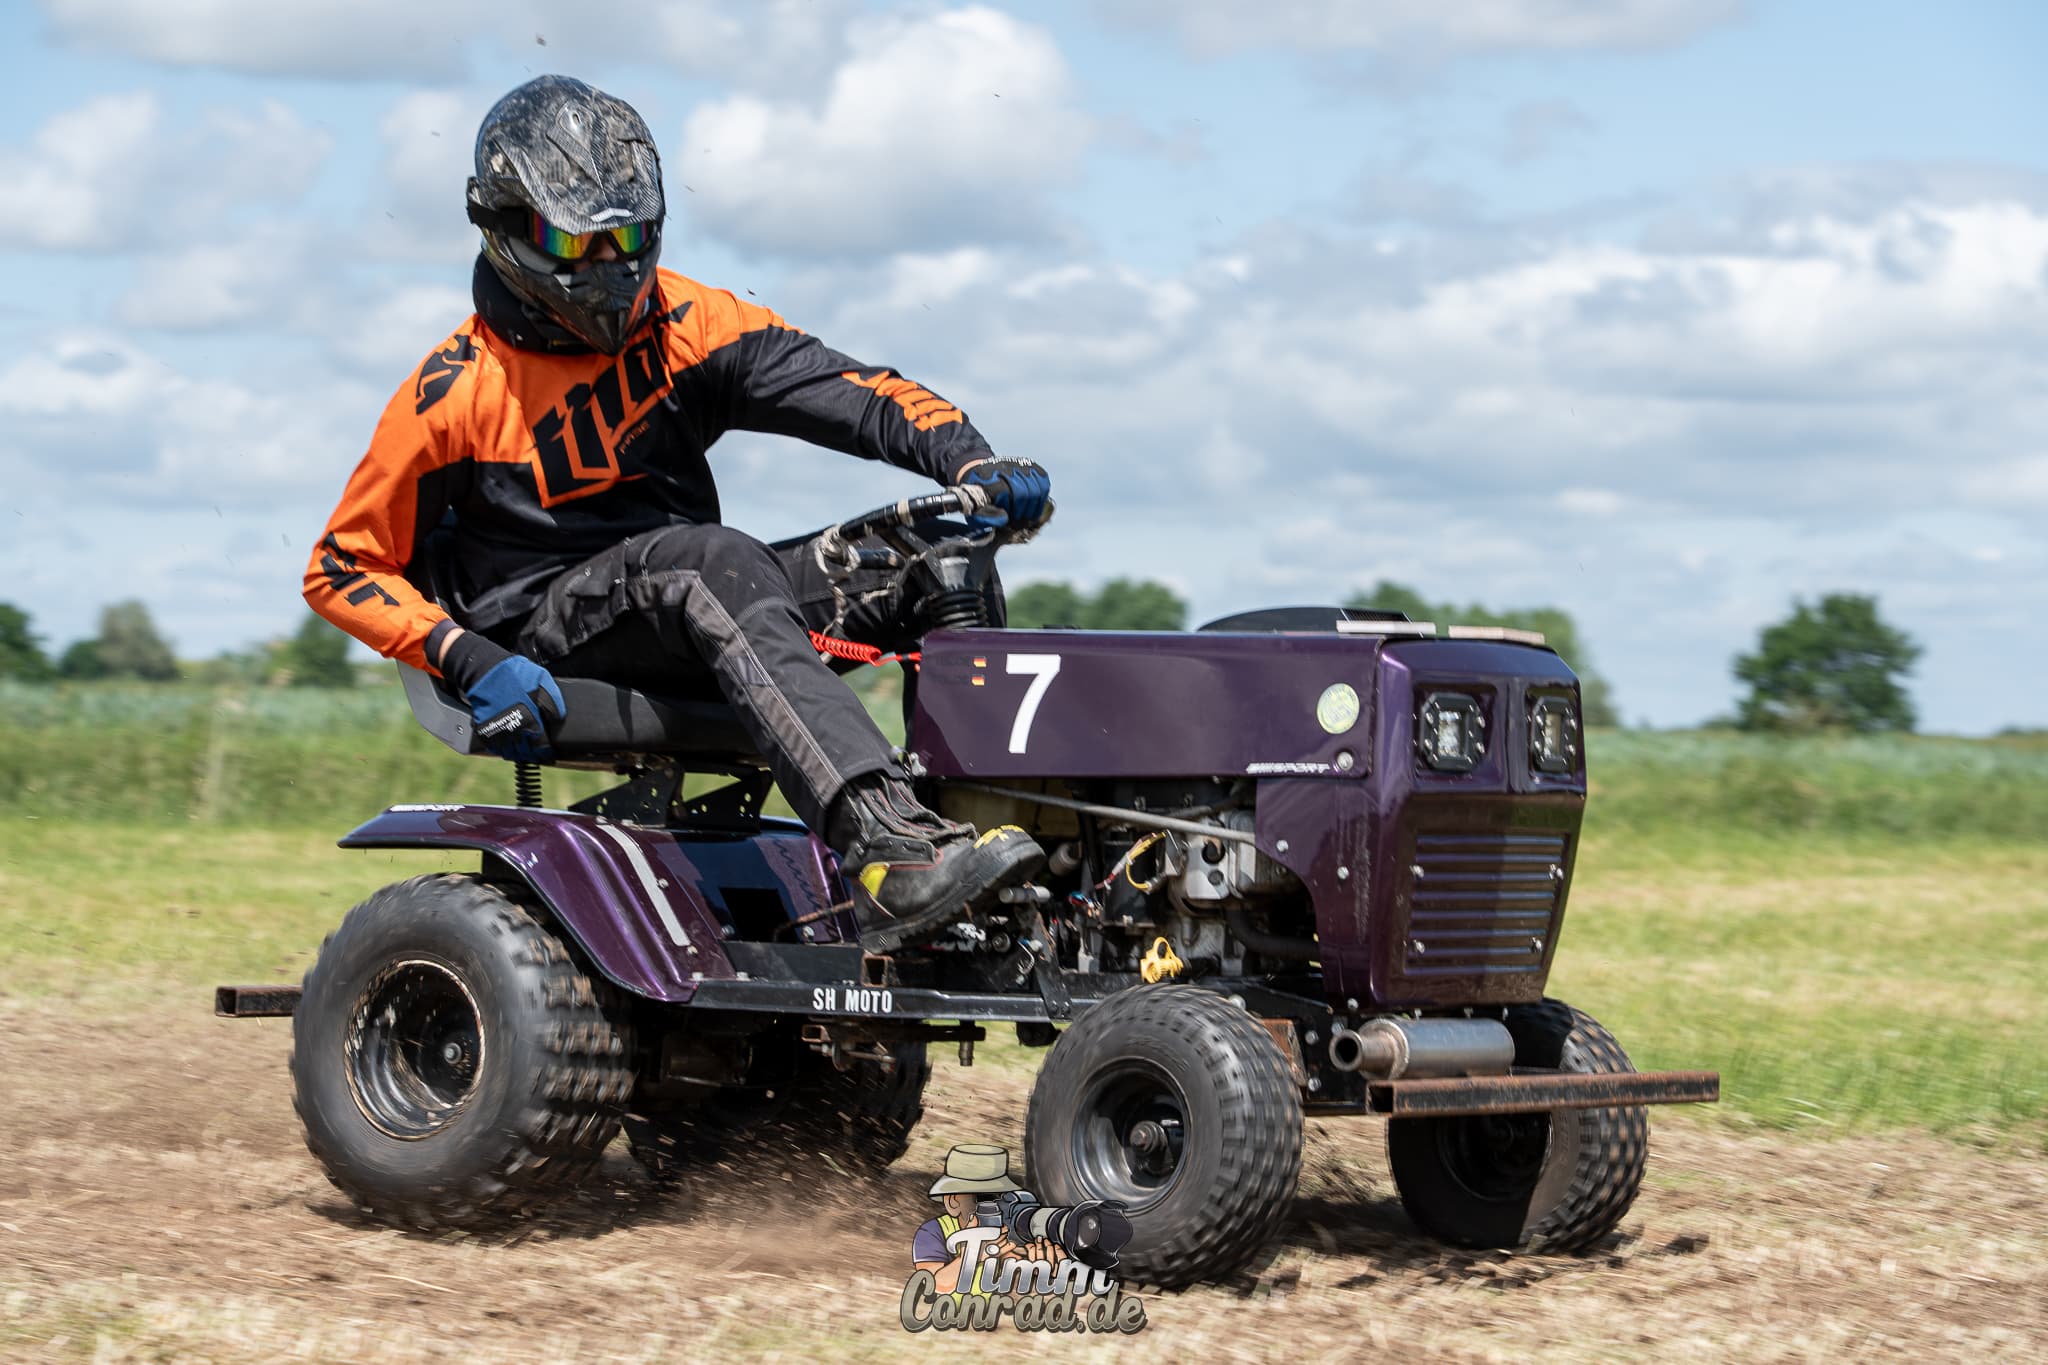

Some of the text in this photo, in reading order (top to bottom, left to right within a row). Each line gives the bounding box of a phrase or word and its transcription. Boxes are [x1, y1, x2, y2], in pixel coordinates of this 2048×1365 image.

[1006, 653, 1061, 754] 7
[812, 987, 893, 1014] SH MOTO
